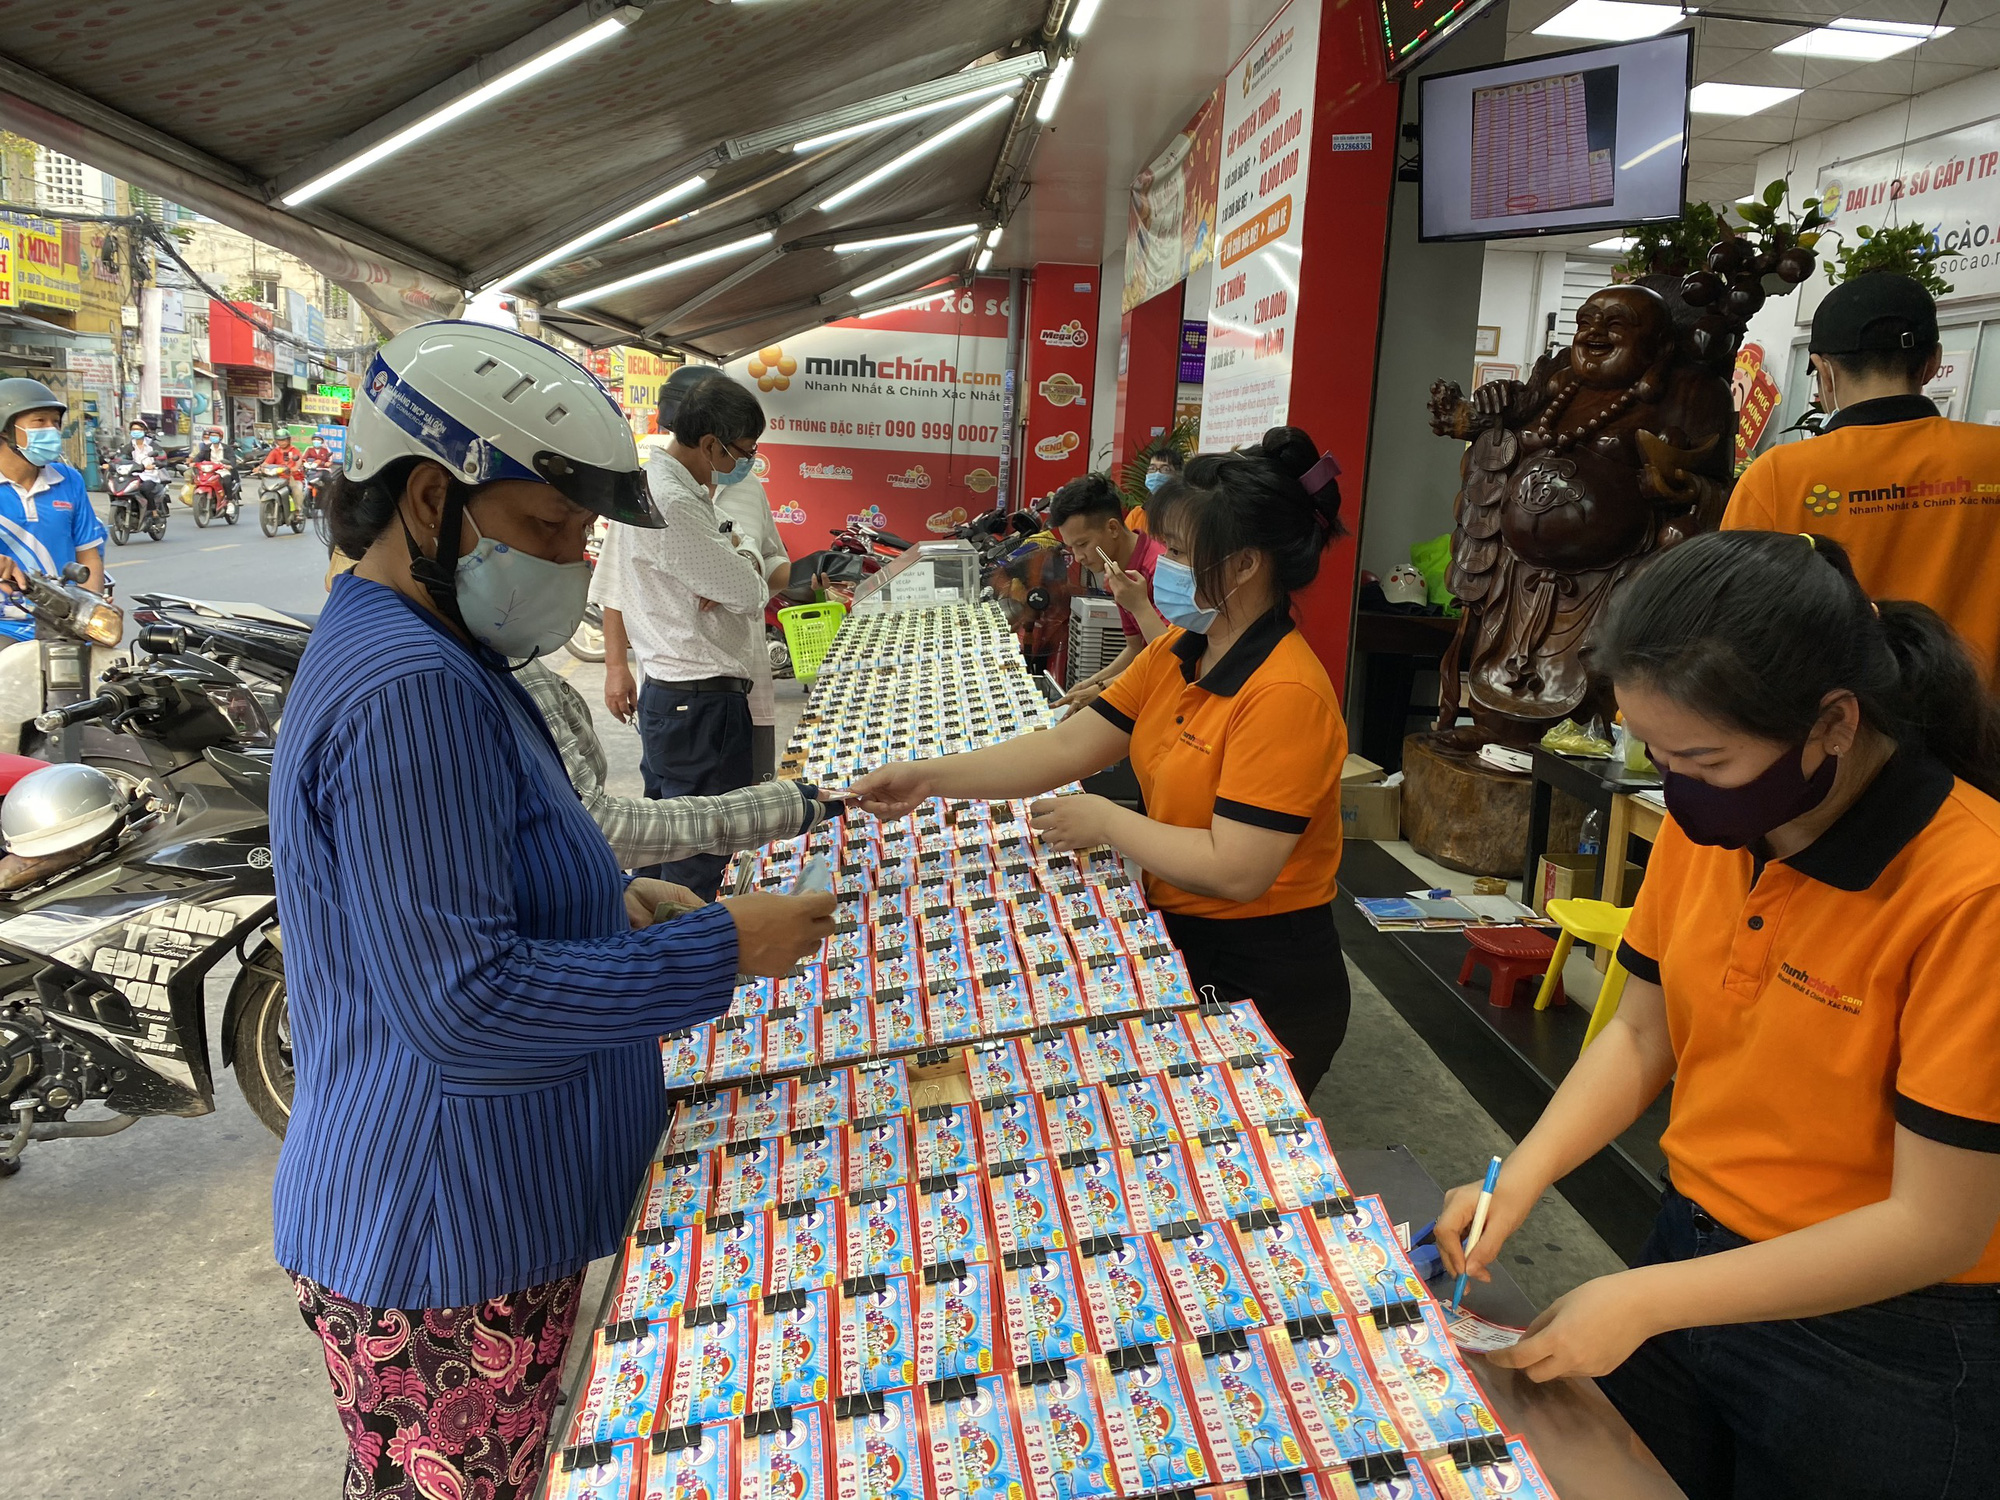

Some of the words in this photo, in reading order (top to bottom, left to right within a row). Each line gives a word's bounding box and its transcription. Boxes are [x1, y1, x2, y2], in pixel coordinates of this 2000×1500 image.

[1846, 186, 1868, 214] ĐẠI
[1871, 176, 1888, 206] LÝ
[1910, 161, 1933, 196] SỐ
[1933, 154, 1964, 190] CẤP
[941, 291, 974, 315] XỔ
[1042, 331, 1072, 340] Mega
[628, 356, 651, 376] DECAL
[805, 354, 1002, 386] minhchính.com
[804, 380, 848, 392] Nhanh
[852, 382, 882, 394] Nhất
[886, 385, 896, 395] &
[900, 385, 938, 398] Chính
[942, 386, 966, 400] Xác
[970, 389, 1000, 402] Nhất
[1754, 386, 1770, 412] CHÚC
[770, 415, 786, 431] SỐ
[789, 418, 826, 434] TRÚNG
[830, 420, 853, 436] ĐẶC
[856, 423, 882, 439] BIỆT
[885, 420, 916, 438] 090
[921, 422, 952, 440] 999
[958, 424, 999, 443] 0007
[1740, 416, 1754, 439] NĂM
[1849, 505, 1884, 516] Nhanh
[1886, 500, 1909, 512] Nhất
[1912, 501, 1920, 509] &
[1924, 496, 1956, 508] Chính
[1960, 495, 1979, 506] Xác
[91, 946, 180, 984] EDIT
[1781, 962, 1863, 1006] minhchính.com
[132, 1038, 176, 1052] speed
[147, 1022, 168, 1043] 5
[1247, 1260, 1283, 1321] 382629
[1328, 1248, 1369, 1307] 361029
[1088, 1282, 1115, 1346] 382627
[1170, 1268, 1208, 1334] 961028
[919, 1312, 934, 1377] 982625
[1008, 1298, 1029, 1363] 382626
[1291, 1381, 1335, 1458] 070918
[1379, 1367, 1431, 1442] 482623
[1106, 1411, 1141, 1486] 733117
[1198, 1396, 1237, 1474] 133118
[1024, 1425, 1056, 1499] 570917
